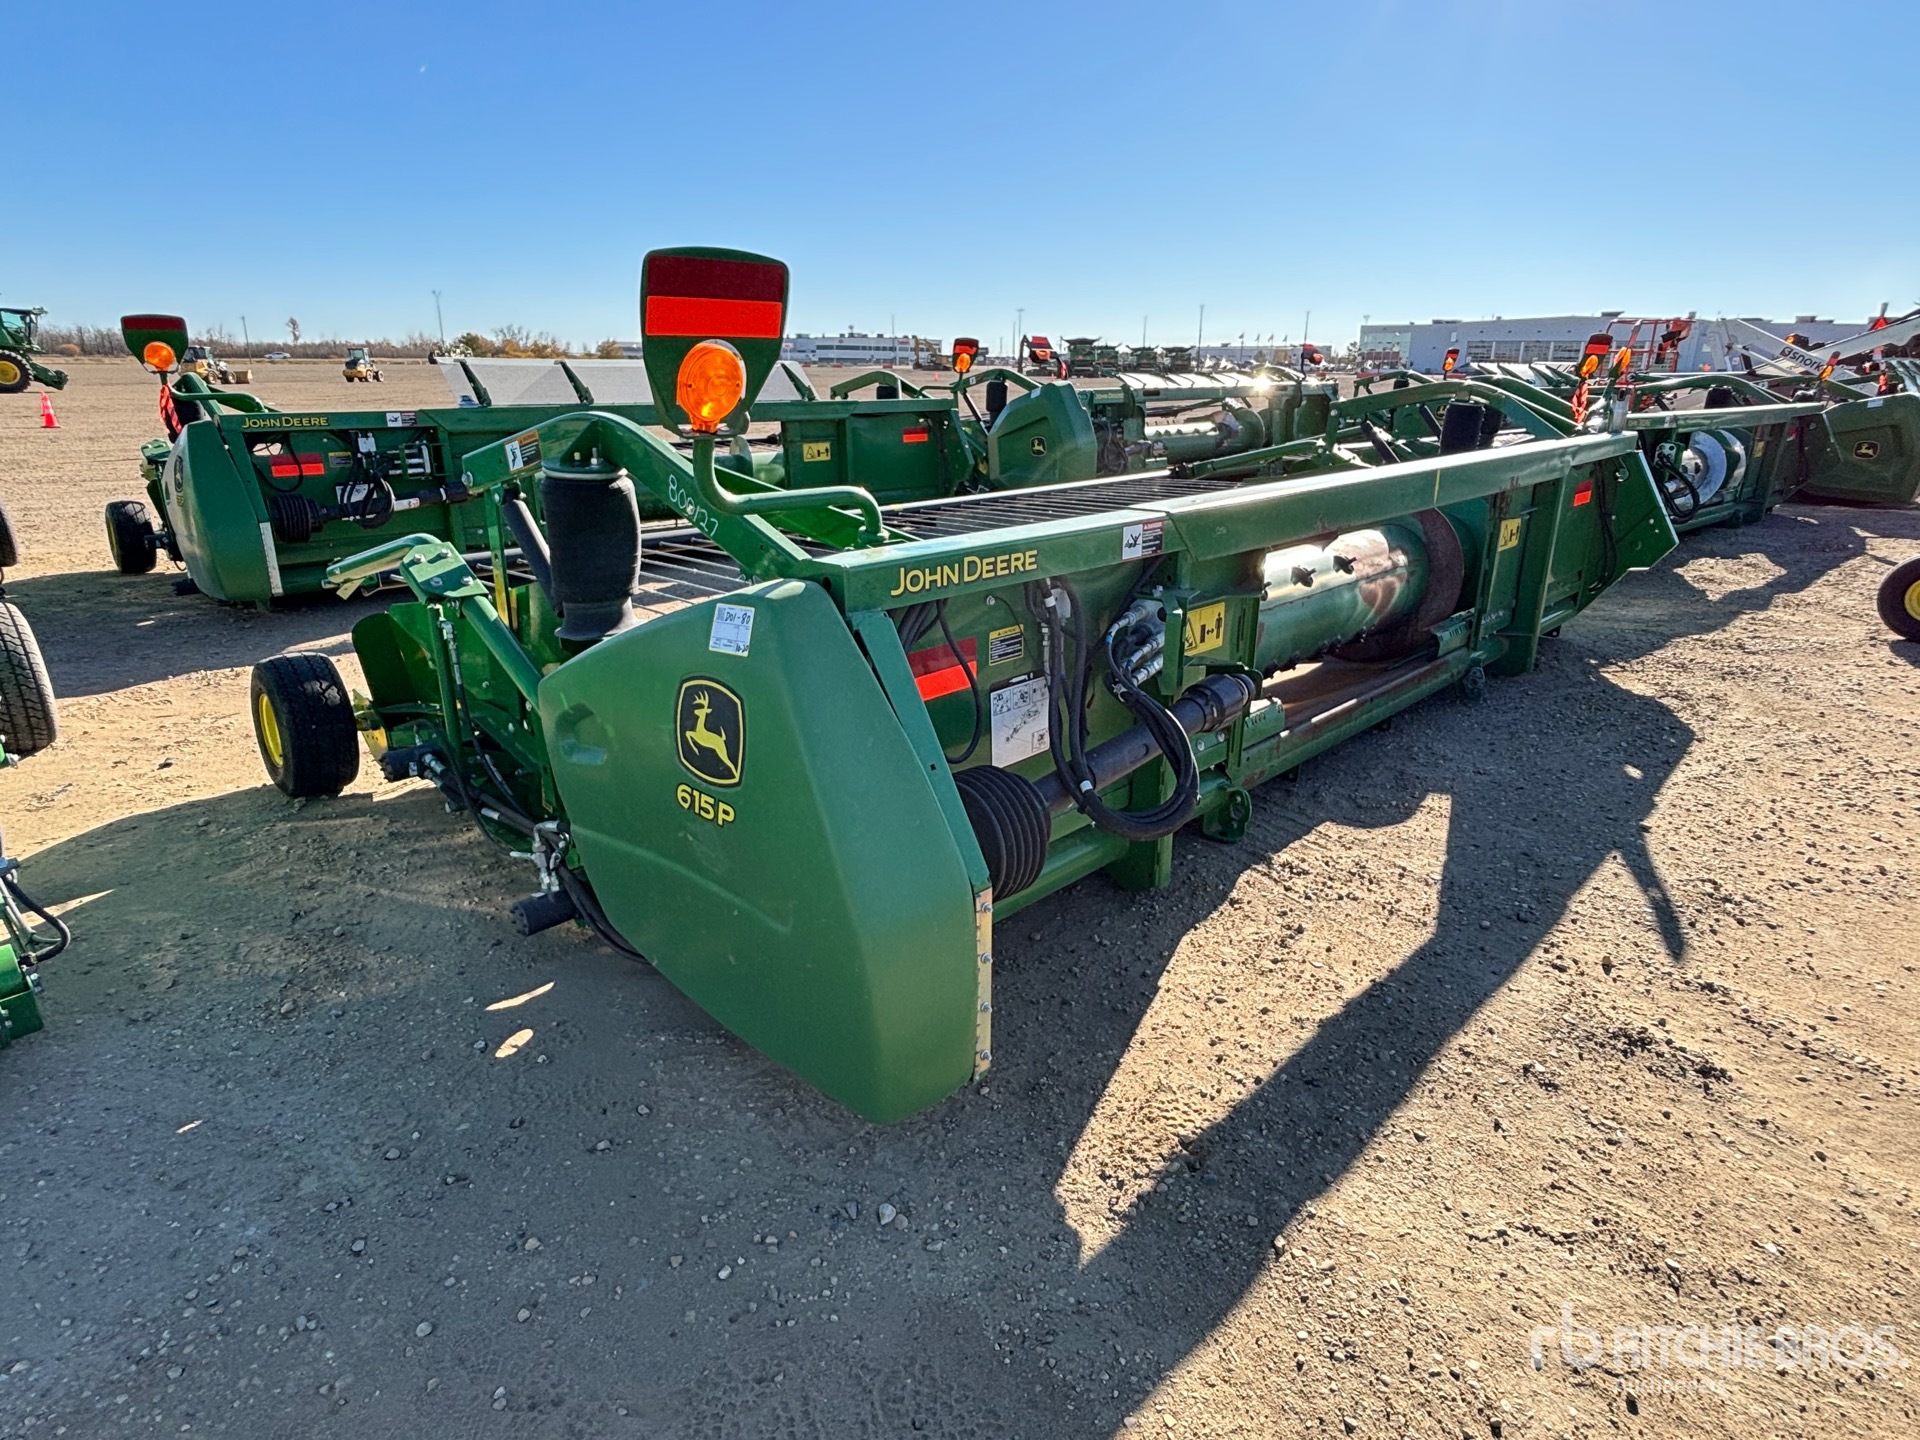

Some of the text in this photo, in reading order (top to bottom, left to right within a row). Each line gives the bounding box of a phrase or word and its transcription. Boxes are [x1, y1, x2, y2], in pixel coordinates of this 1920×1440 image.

[1789, 350, 1825, 373] snork
[242, 416, 329, 428] JOHN DEERE
[890, 549, 1038, 596] JOHN DEERE
[676, 783, 736, 827] 615P
